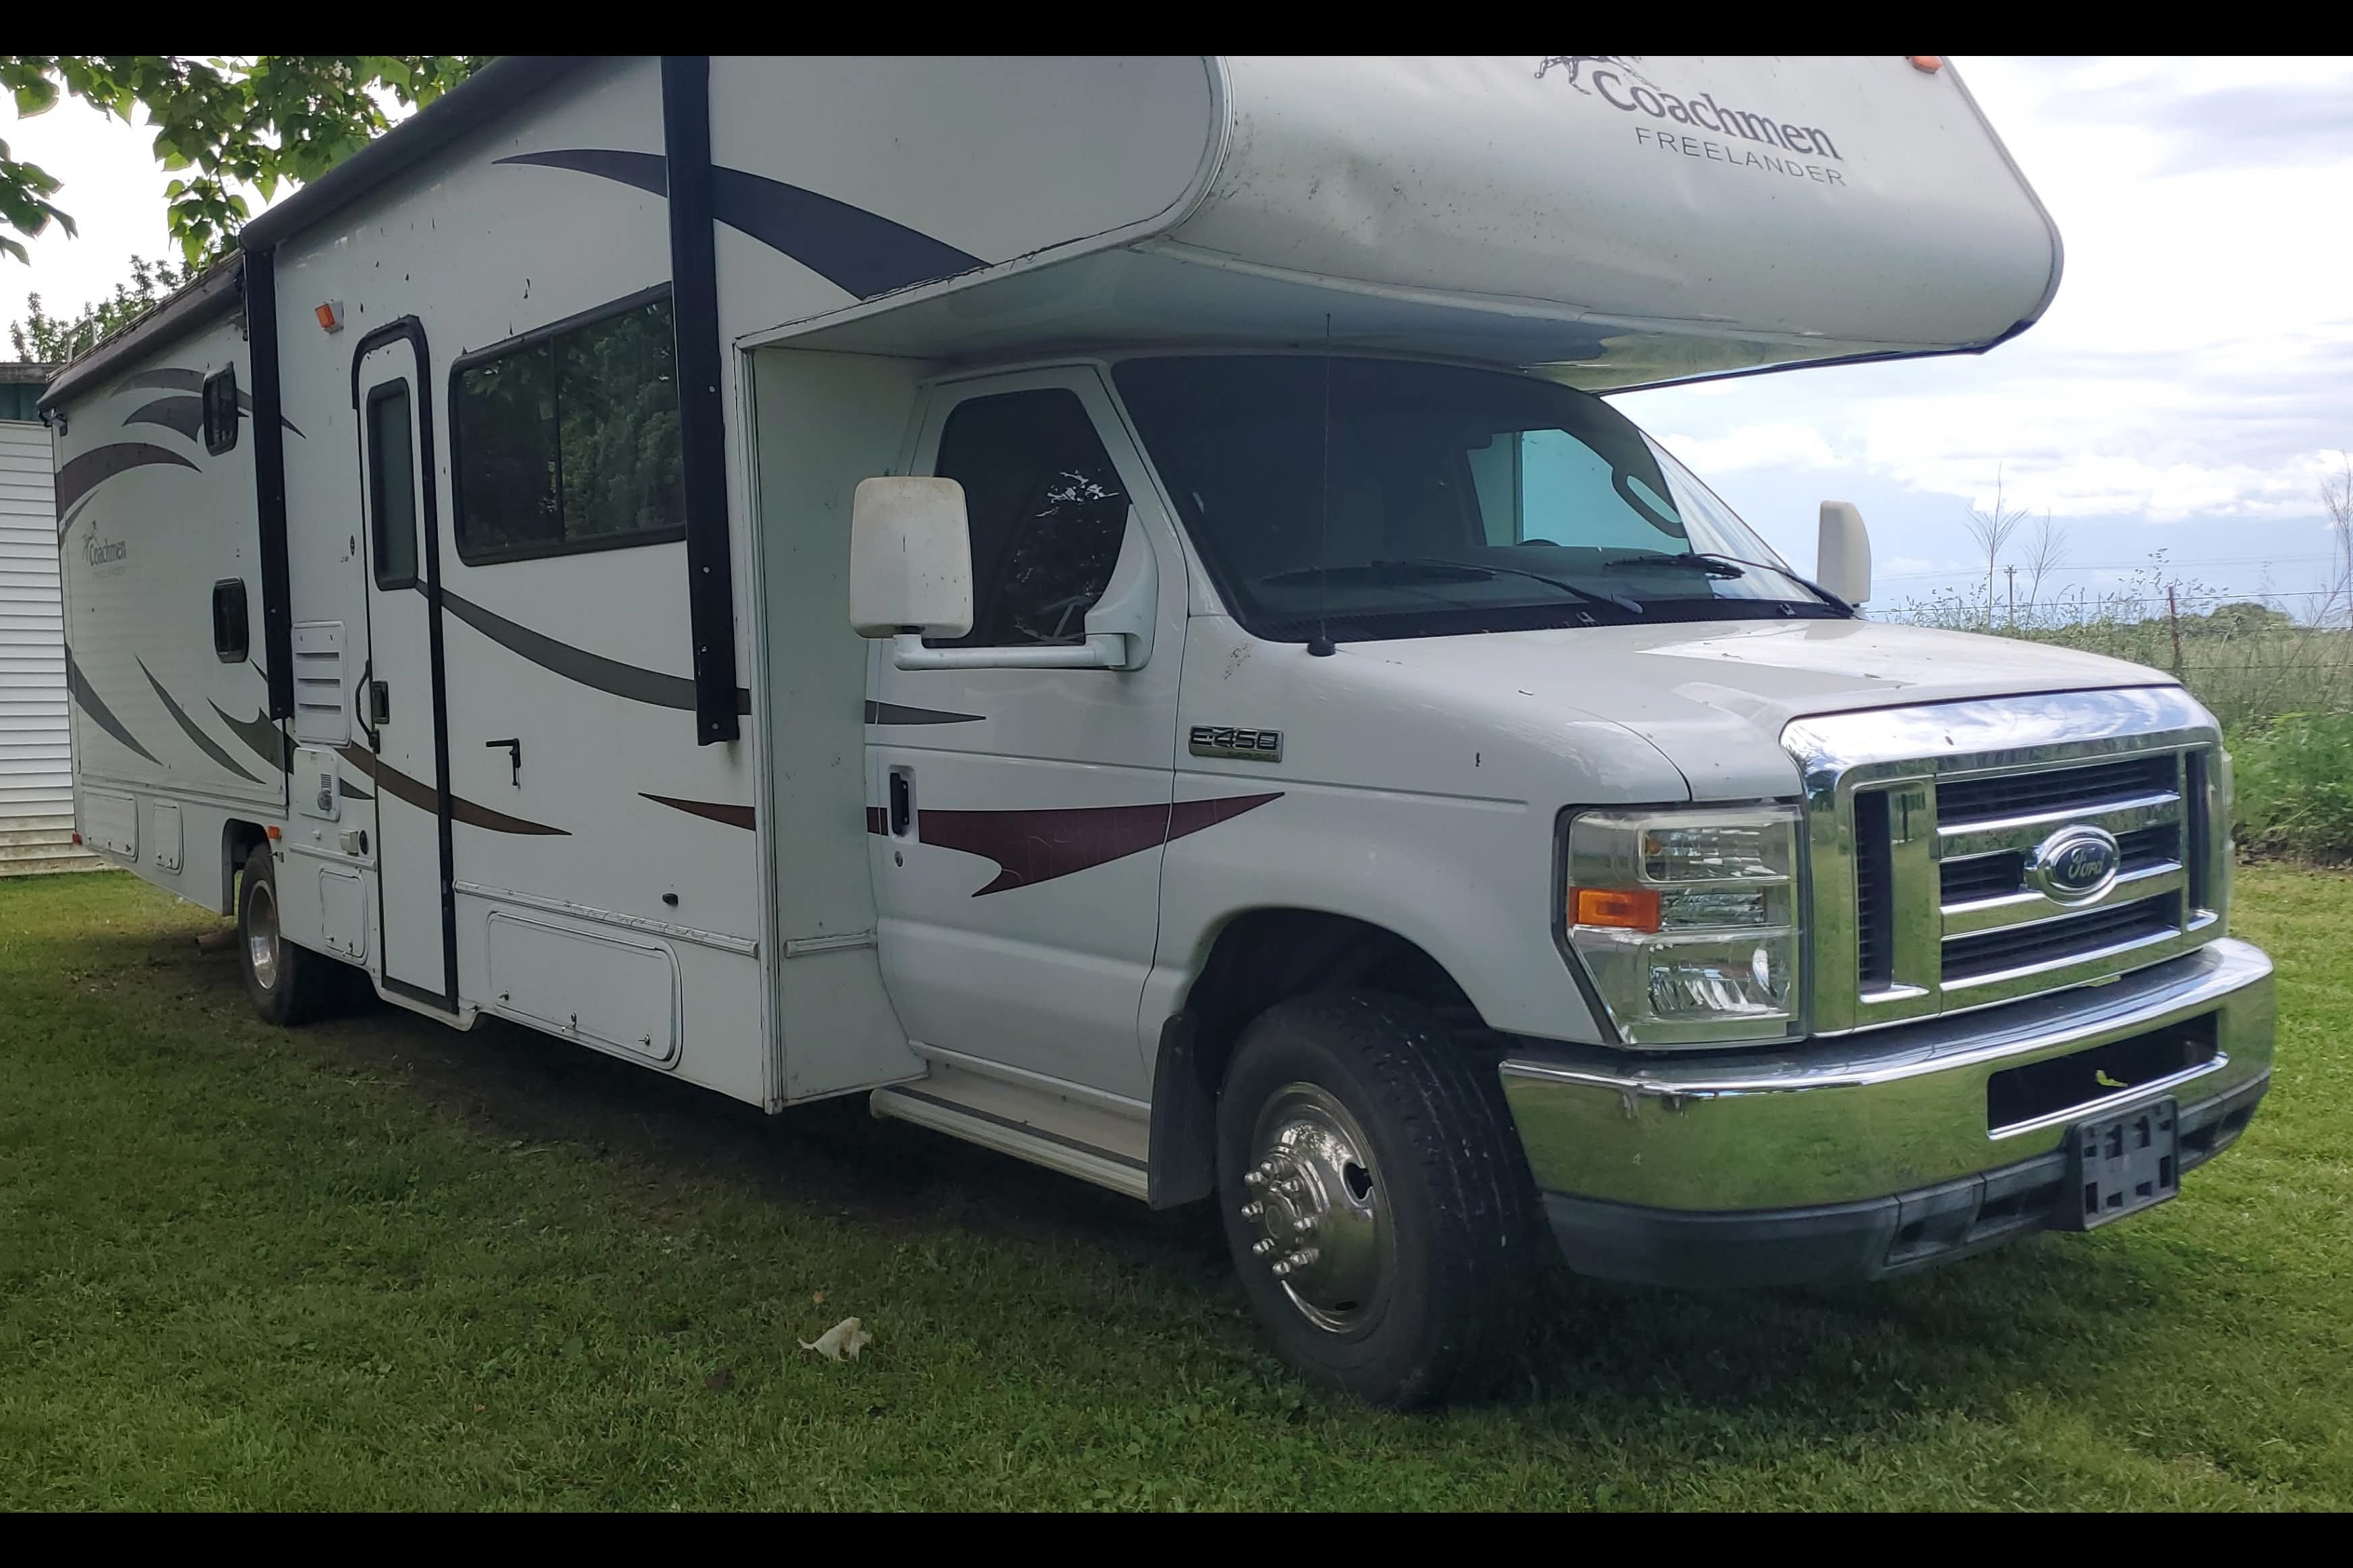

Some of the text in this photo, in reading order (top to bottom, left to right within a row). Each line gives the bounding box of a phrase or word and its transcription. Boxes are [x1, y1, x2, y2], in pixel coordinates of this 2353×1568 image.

[1593, 70, 1843, 161] Coachmen
[1635, 127, 1846, 186] FREELANDER
[2068, 848, 2105, 879] Ford
